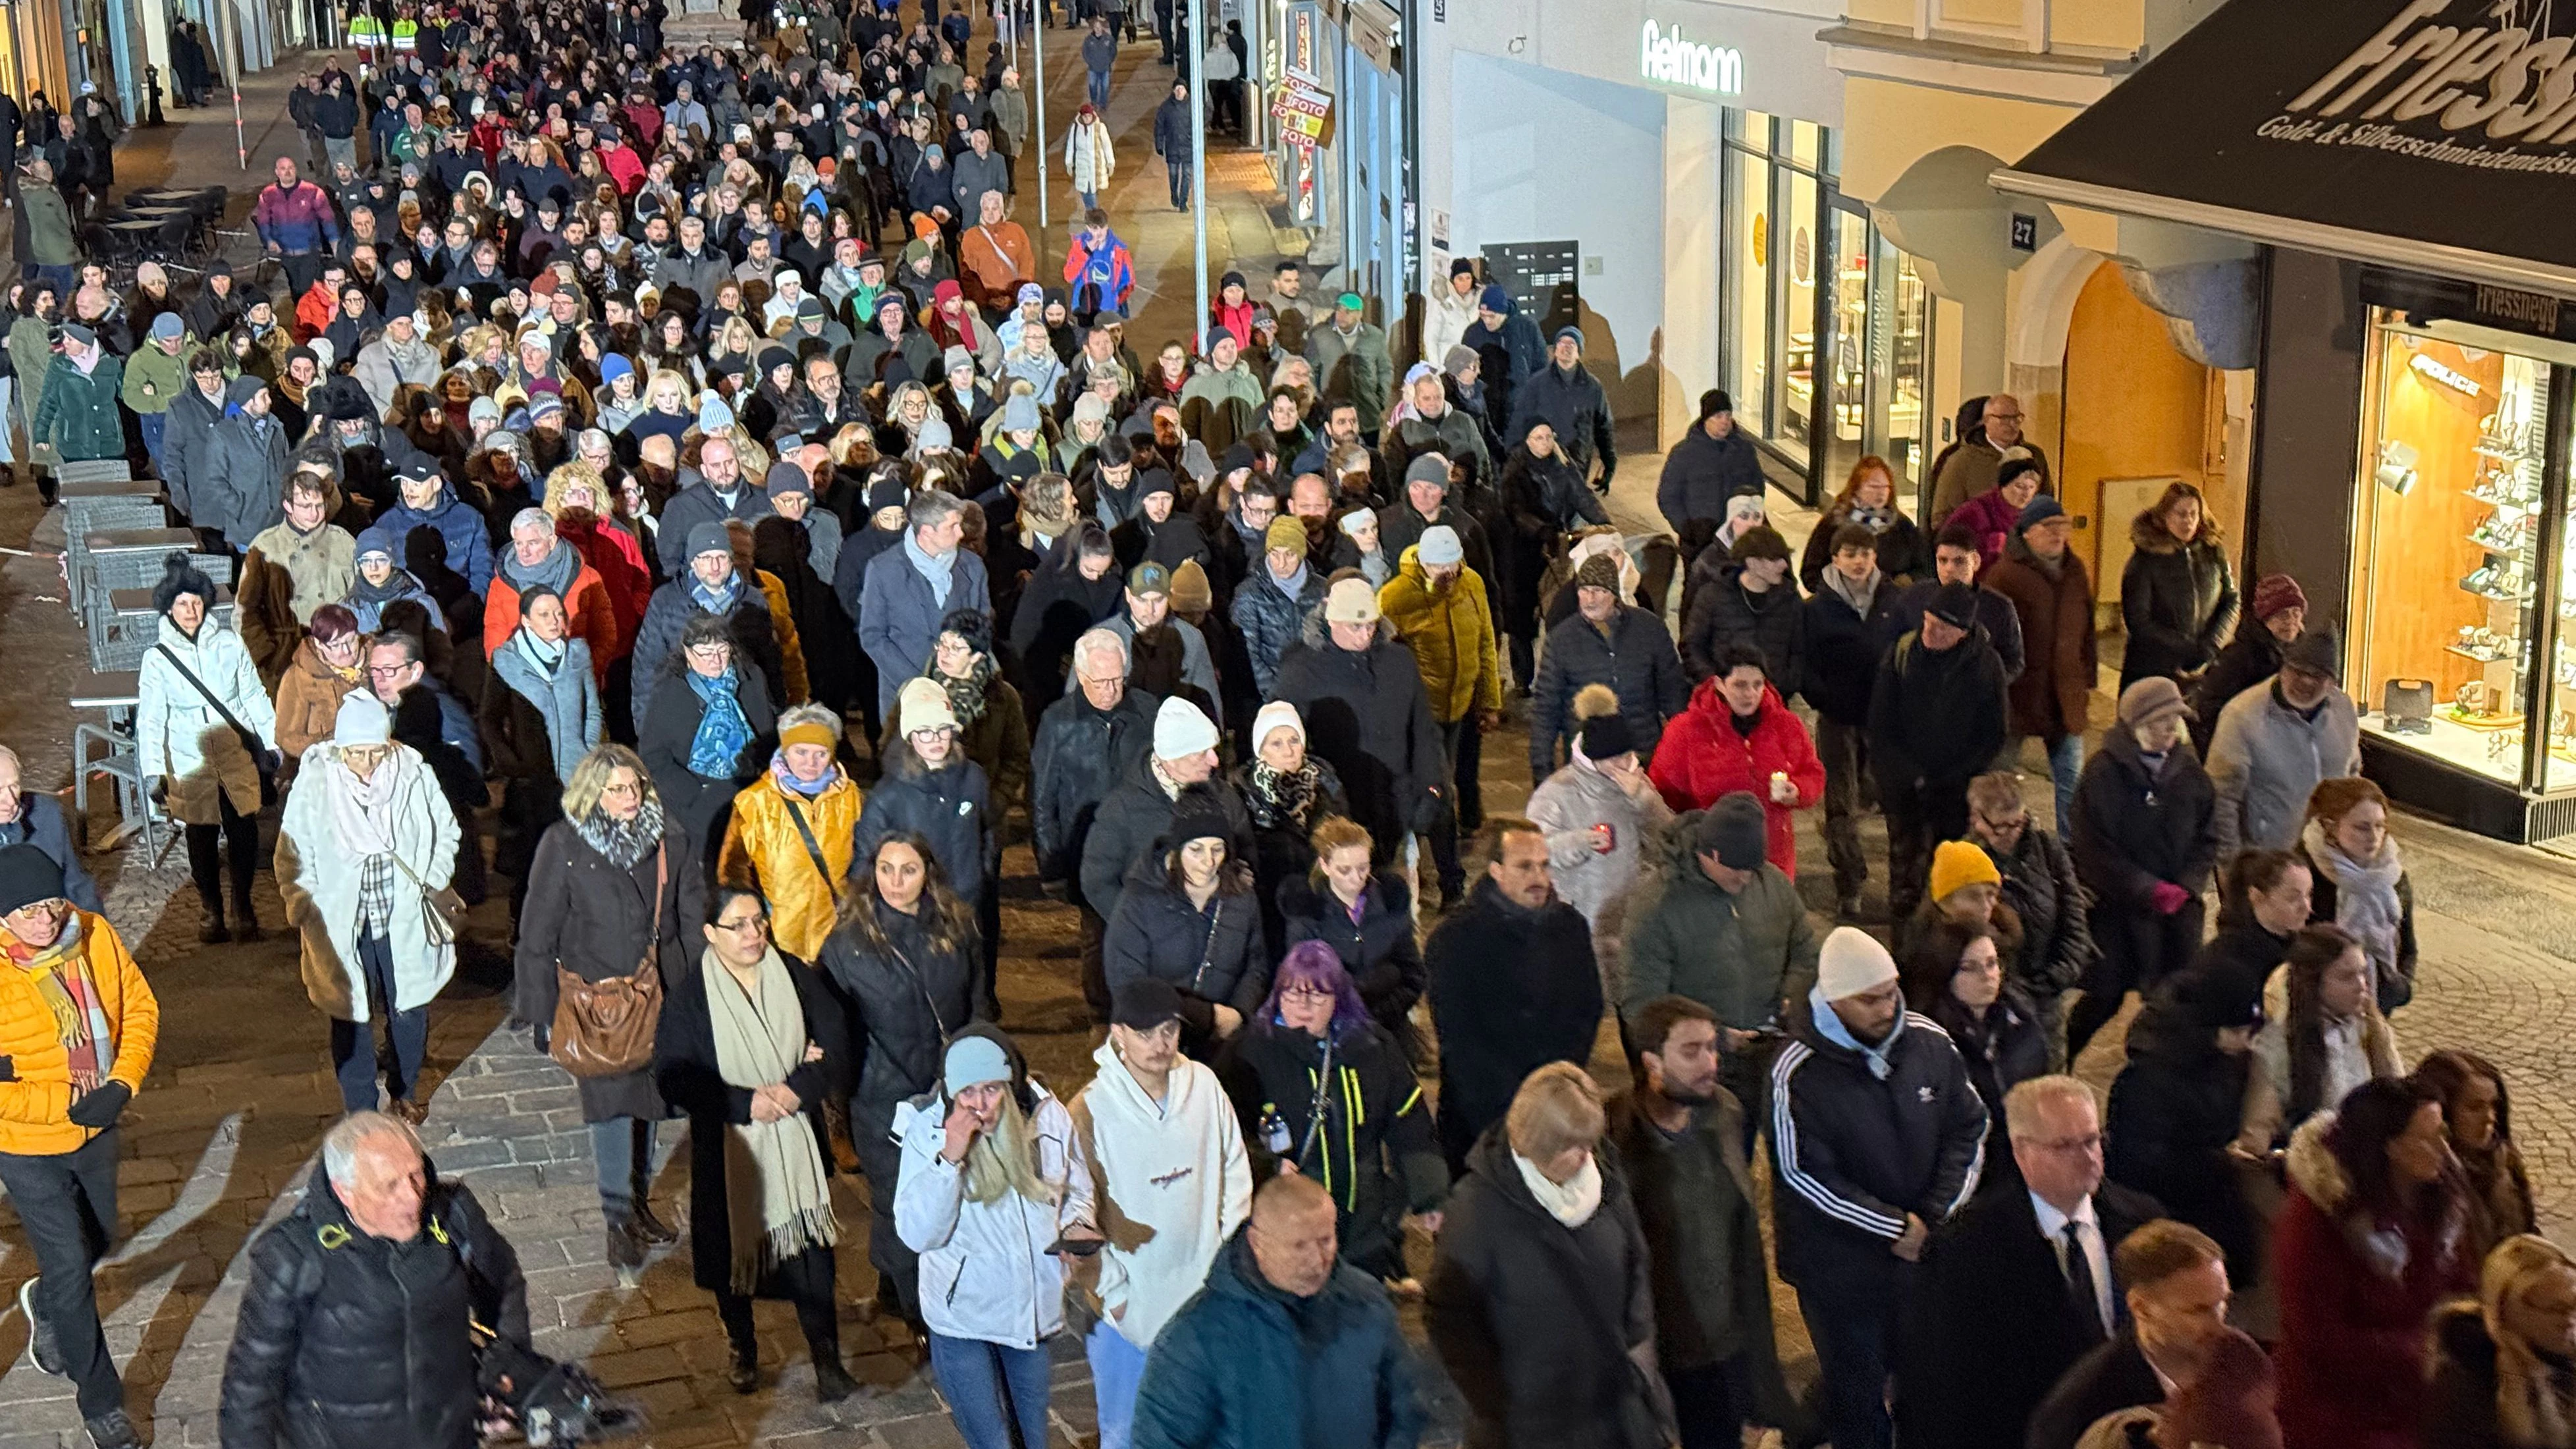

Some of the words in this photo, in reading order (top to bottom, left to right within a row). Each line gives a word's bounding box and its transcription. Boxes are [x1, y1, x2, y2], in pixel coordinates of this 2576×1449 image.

[1271, 103, 1288, 117] FO
[1291, 97, 1326, 117] FOTO
[1280, 128, 1316, 147] FOTO
[2257, 115, 2324, 141] Gold-
[2314, 123, 2350, 144] &
[2014, 221, 2032, 244] 27
[2409, 354, 2481, 397] POLICE
